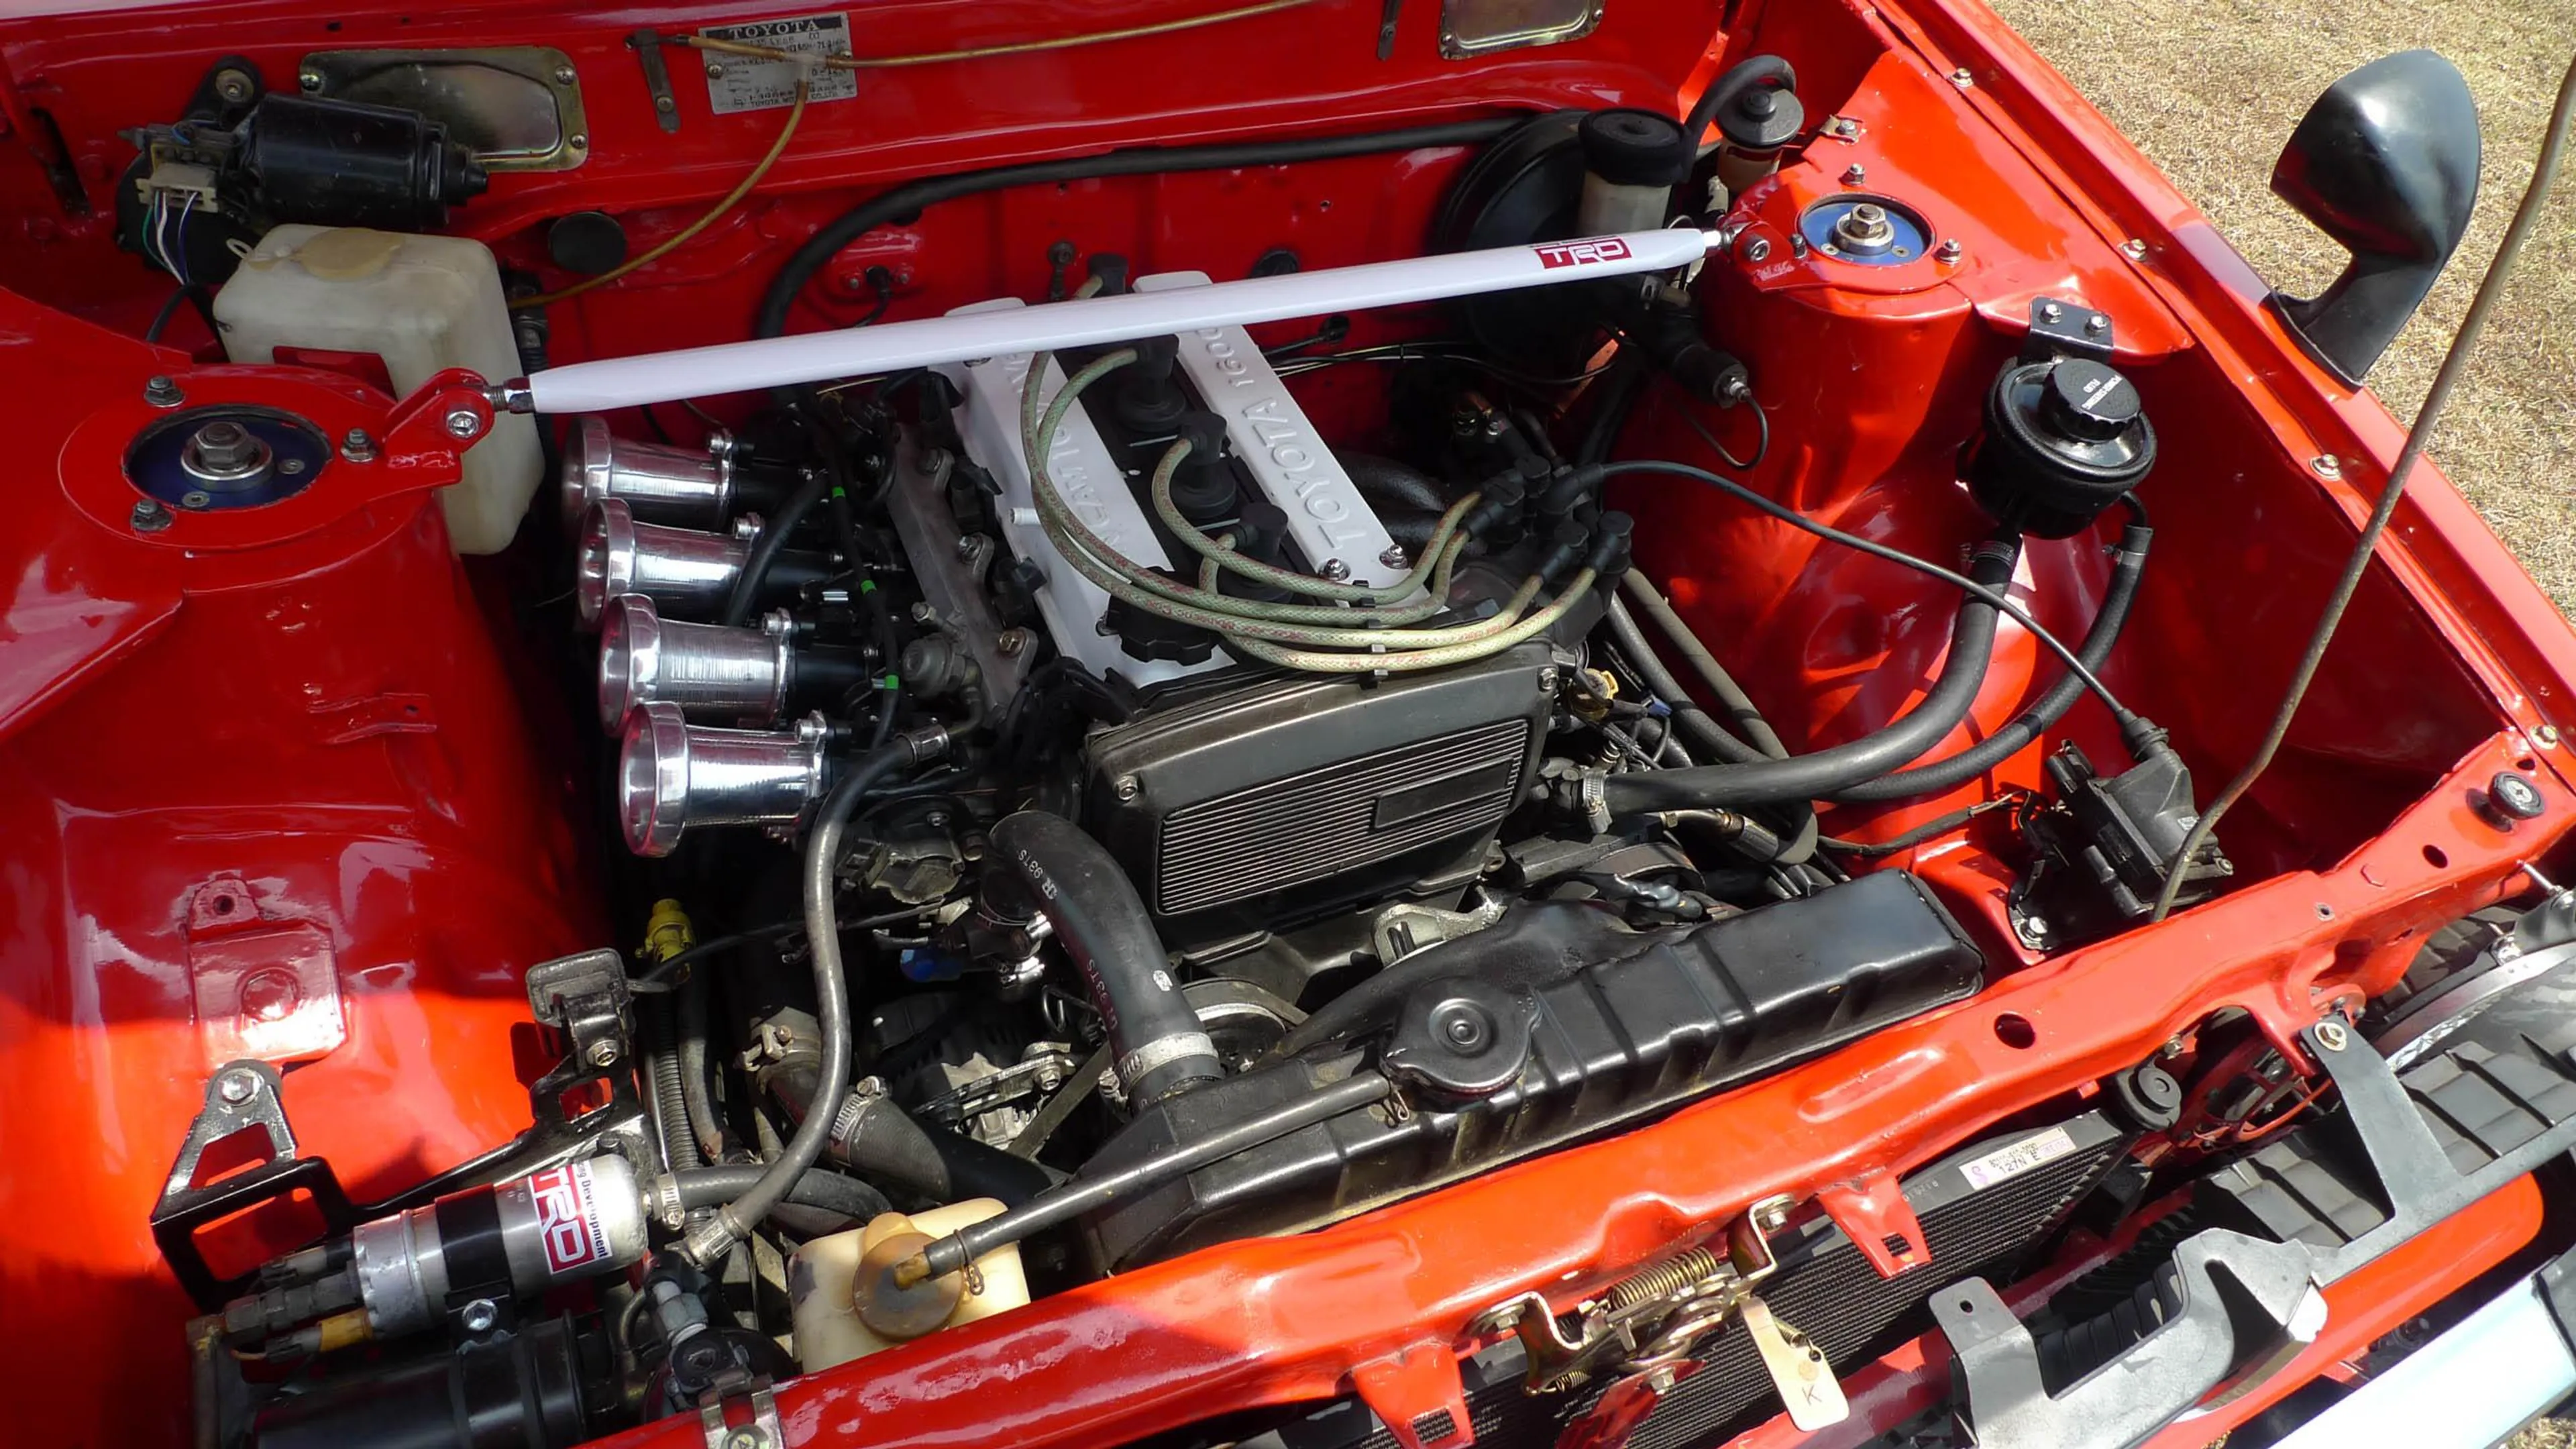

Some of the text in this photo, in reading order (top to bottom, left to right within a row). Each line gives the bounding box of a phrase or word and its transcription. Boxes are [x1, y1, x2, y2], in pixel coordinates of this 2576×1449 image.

[729, 20, 819, 40] TOYOTA
[1538, 239, 1626, 266] TRD
[1242, 397, 1368, 551] TOYOTA
[534, 1167, 586, 1265] TRD
[1801, 1384, 1823, 1406] K
